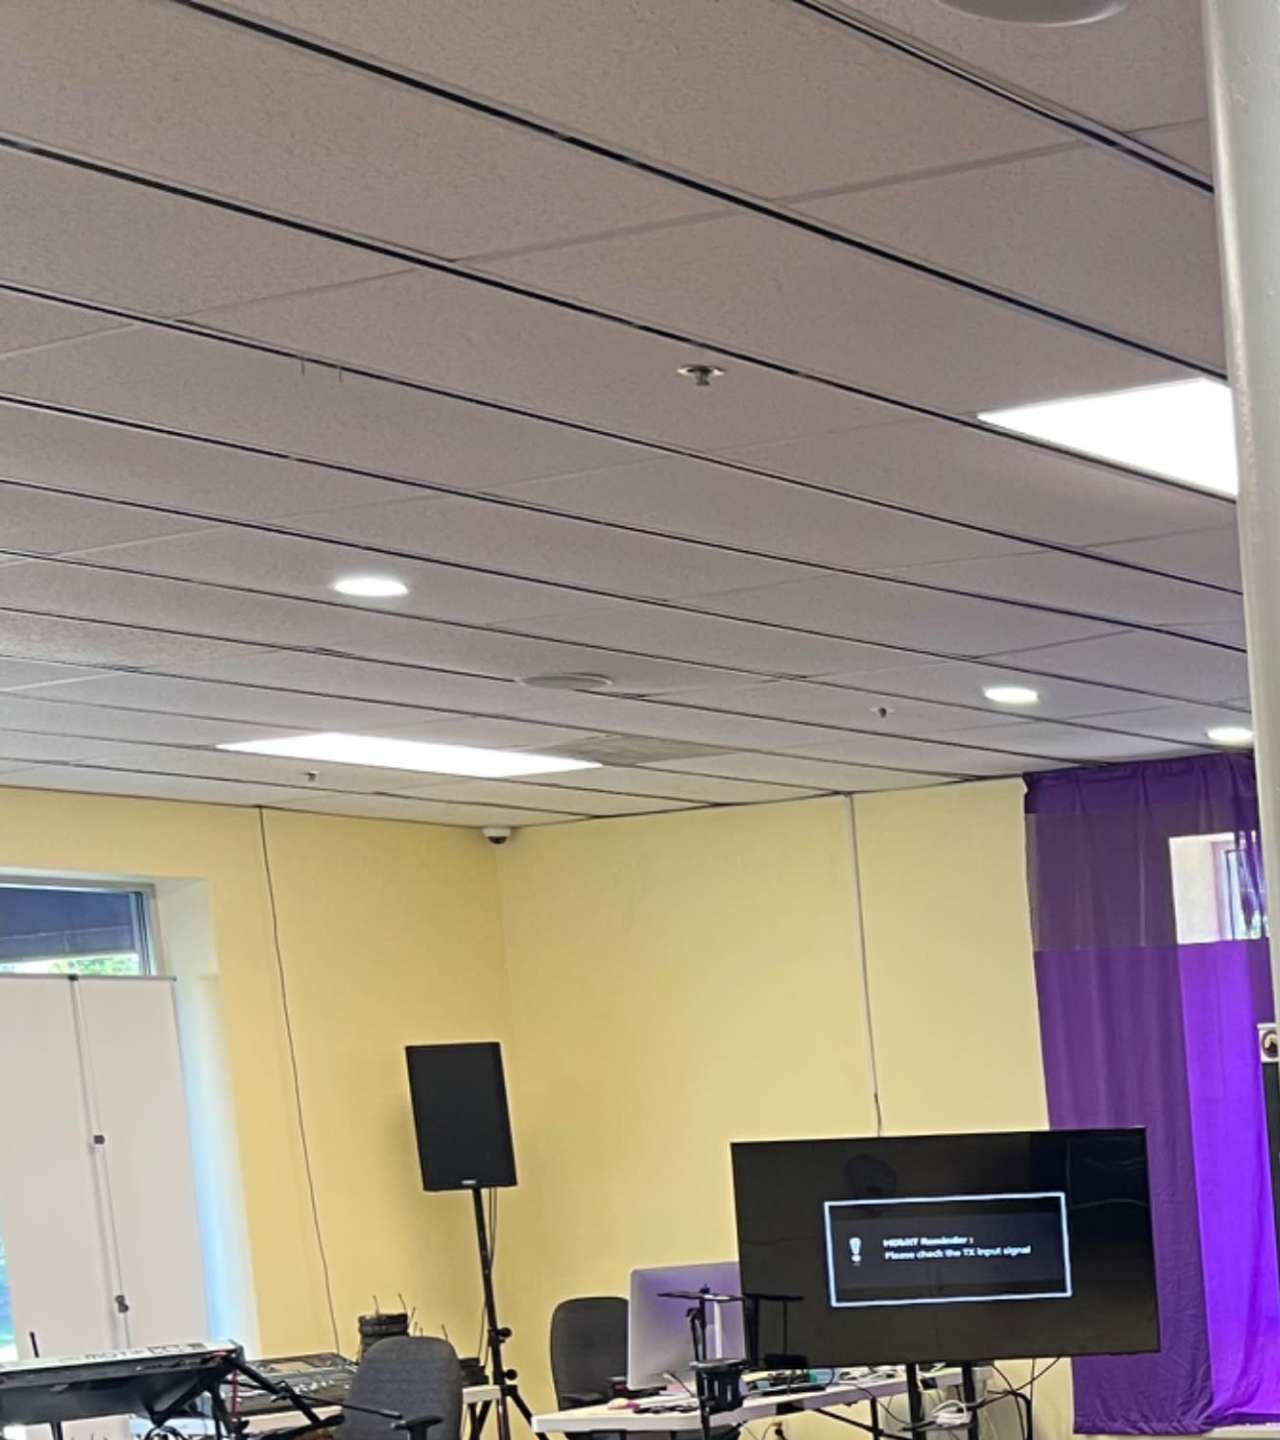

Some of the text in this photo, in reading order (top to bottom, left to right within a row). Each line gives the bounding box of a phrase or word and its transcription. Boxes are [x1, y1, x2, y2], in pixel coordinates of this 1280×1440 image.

[885, 1250, 915, 1260] Please
[917, 1249, 943, 1259] check
[945, 1248, 961, 1258] the
[977, 1246, 1001, 1258] input
[1003, 1245, 1031, 1257] signal
